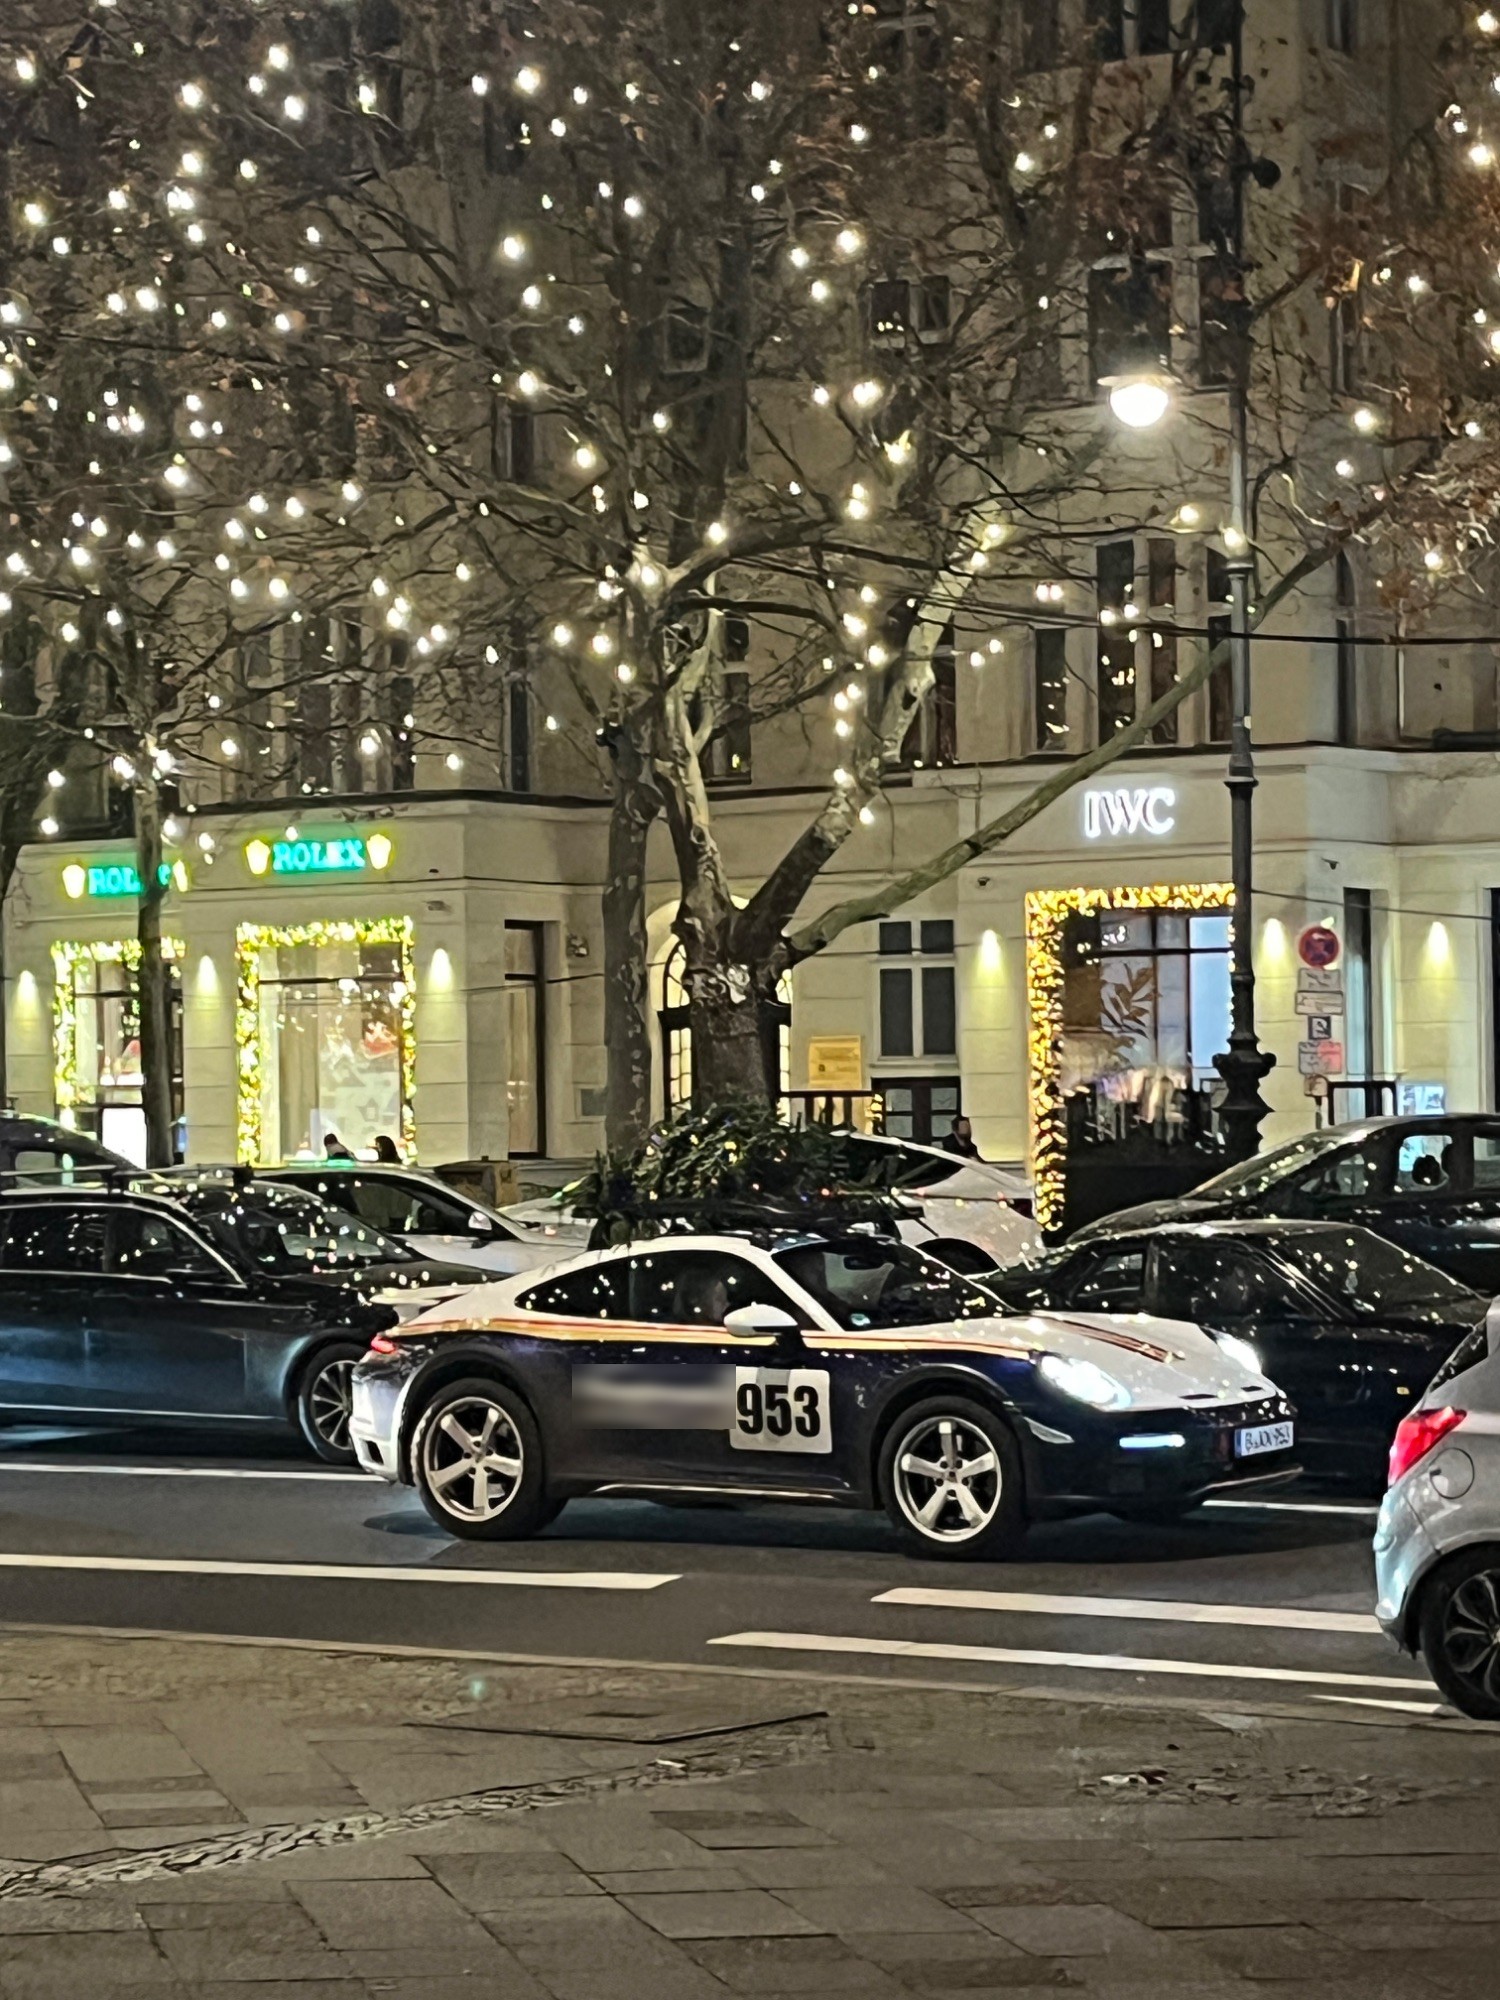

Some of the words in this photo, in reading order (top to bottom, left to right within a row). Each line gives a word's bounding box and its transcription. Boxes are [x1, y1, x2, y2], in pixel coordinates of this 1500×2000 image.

[1084, 787, 1176, 838] IWC
[273, 839, 366, 871] ROLEX
[737, 1383, 821, 1438] 953
